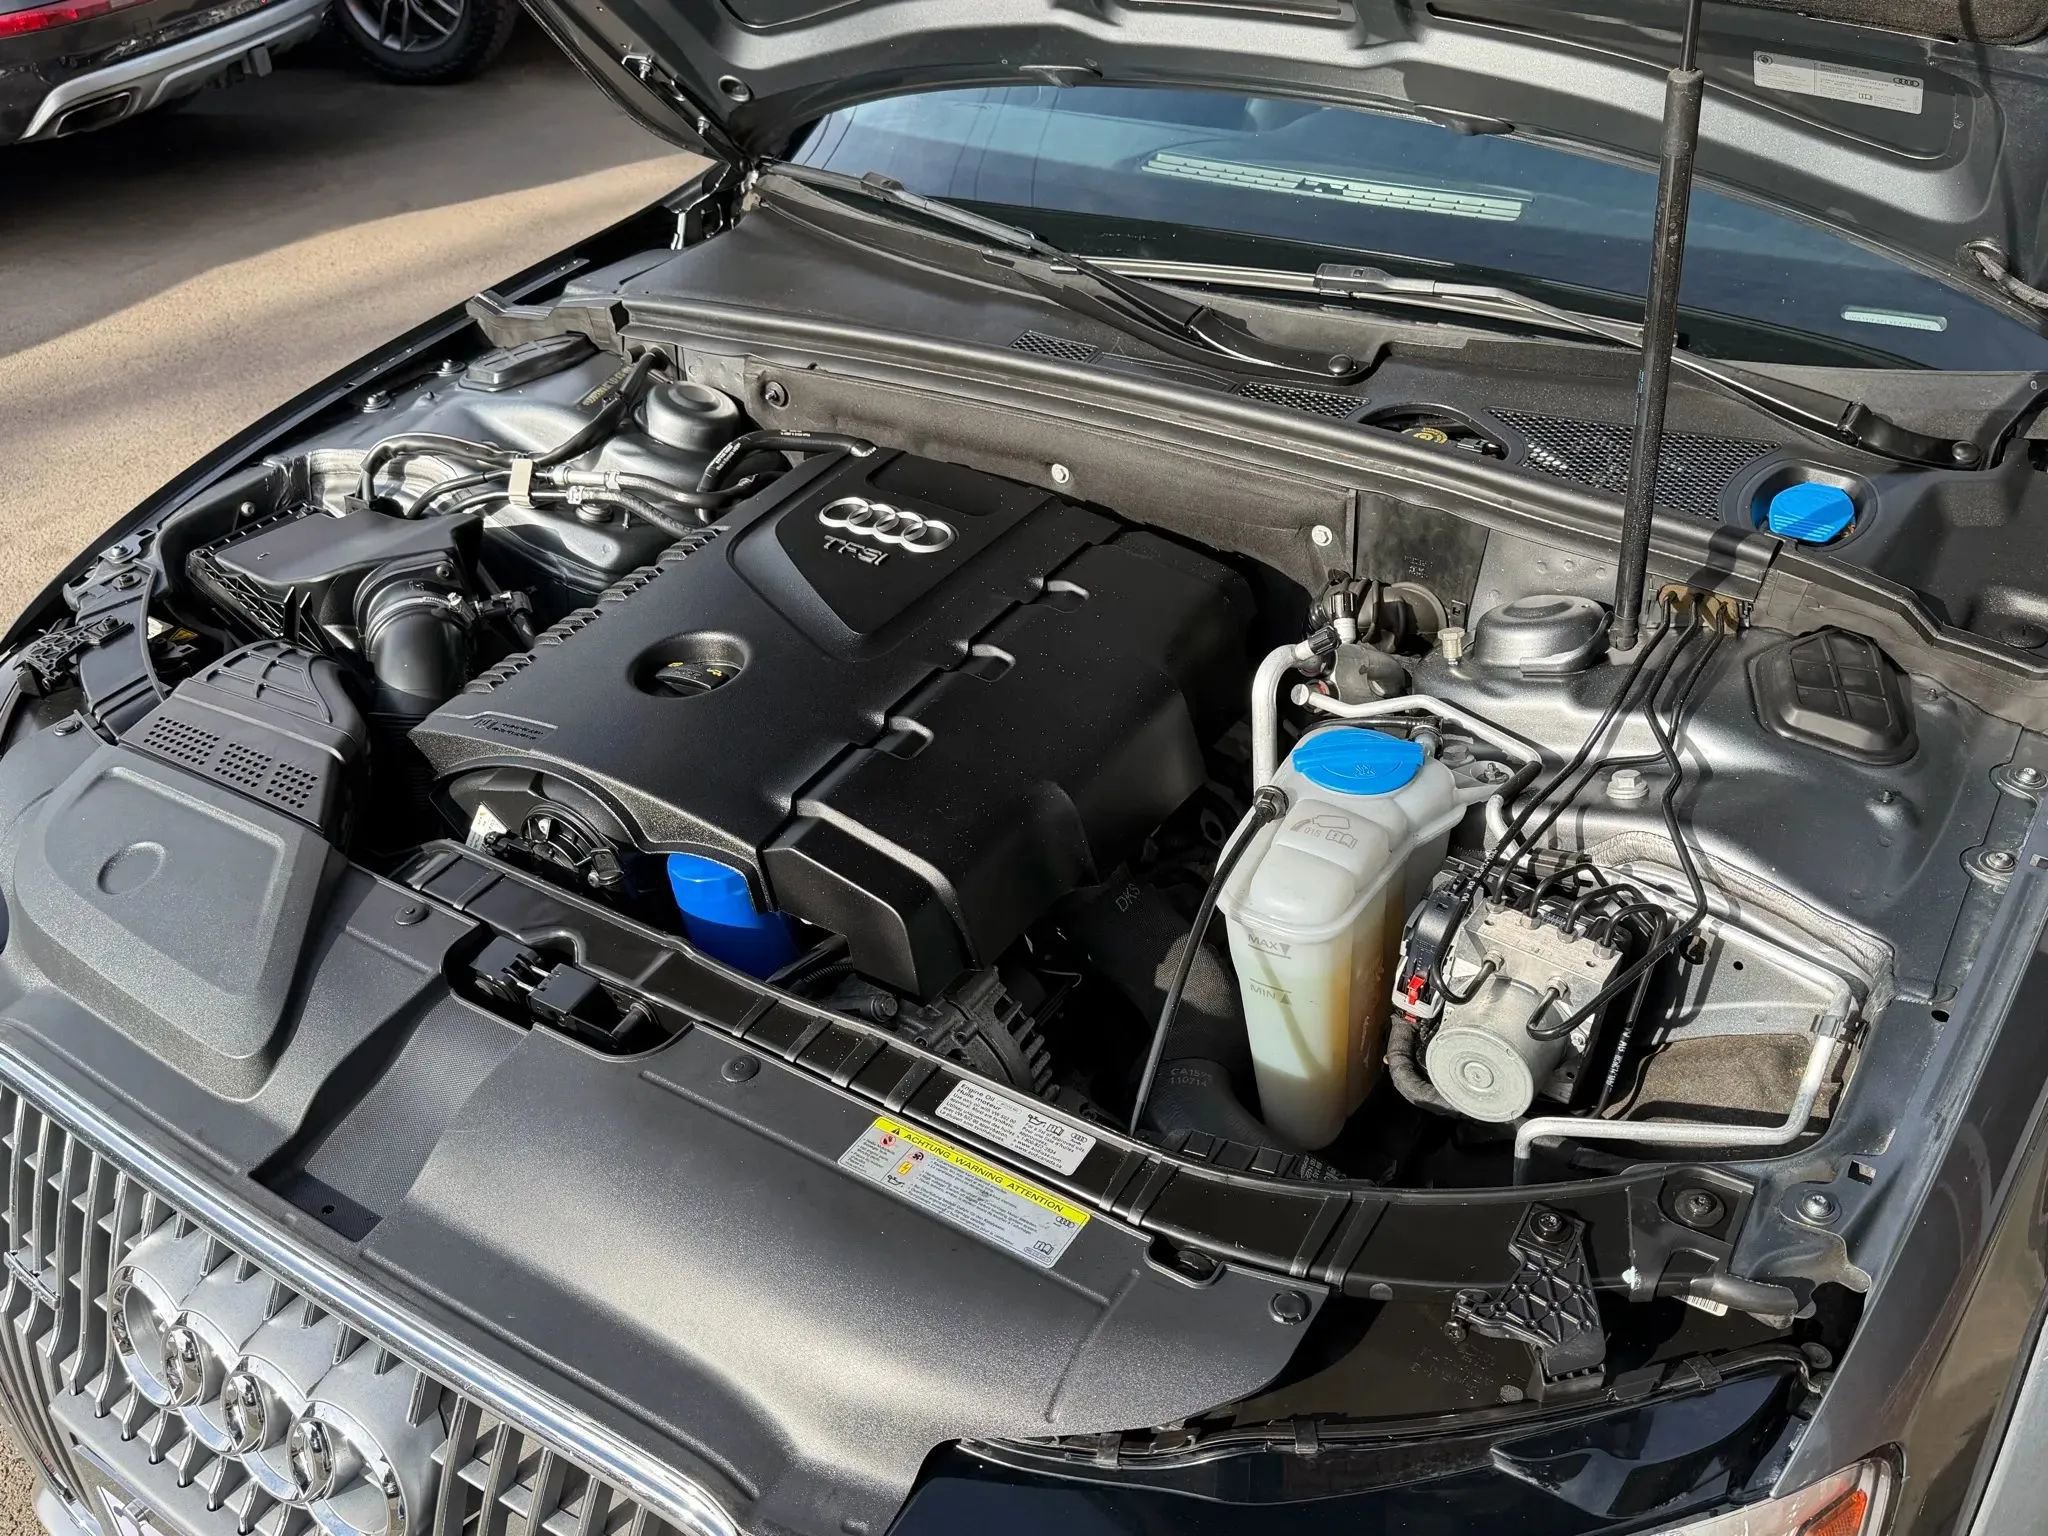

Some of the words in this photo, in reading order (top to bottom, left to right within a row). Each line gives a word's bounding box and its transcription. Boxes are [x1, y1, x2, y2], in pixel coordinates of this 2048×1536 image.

[822, 534, 889, 566] TFSI
[1248, 934, 1278, 950] MAX
[1250, 983, 1276, 1000] MIN
[956, 1088, 974, 1098] Huile
[974, 1096, 1001, 1111] moteur
[959, 1083, 984, 1097] Engine
[984, 1094, 995, 1102] Oil
[904, 1134, 951, 1159] ACHTUNG
[954, 1157, 1004, 1184] WARNING
[1007, 1182, 1064, 1212] ATTENTION
